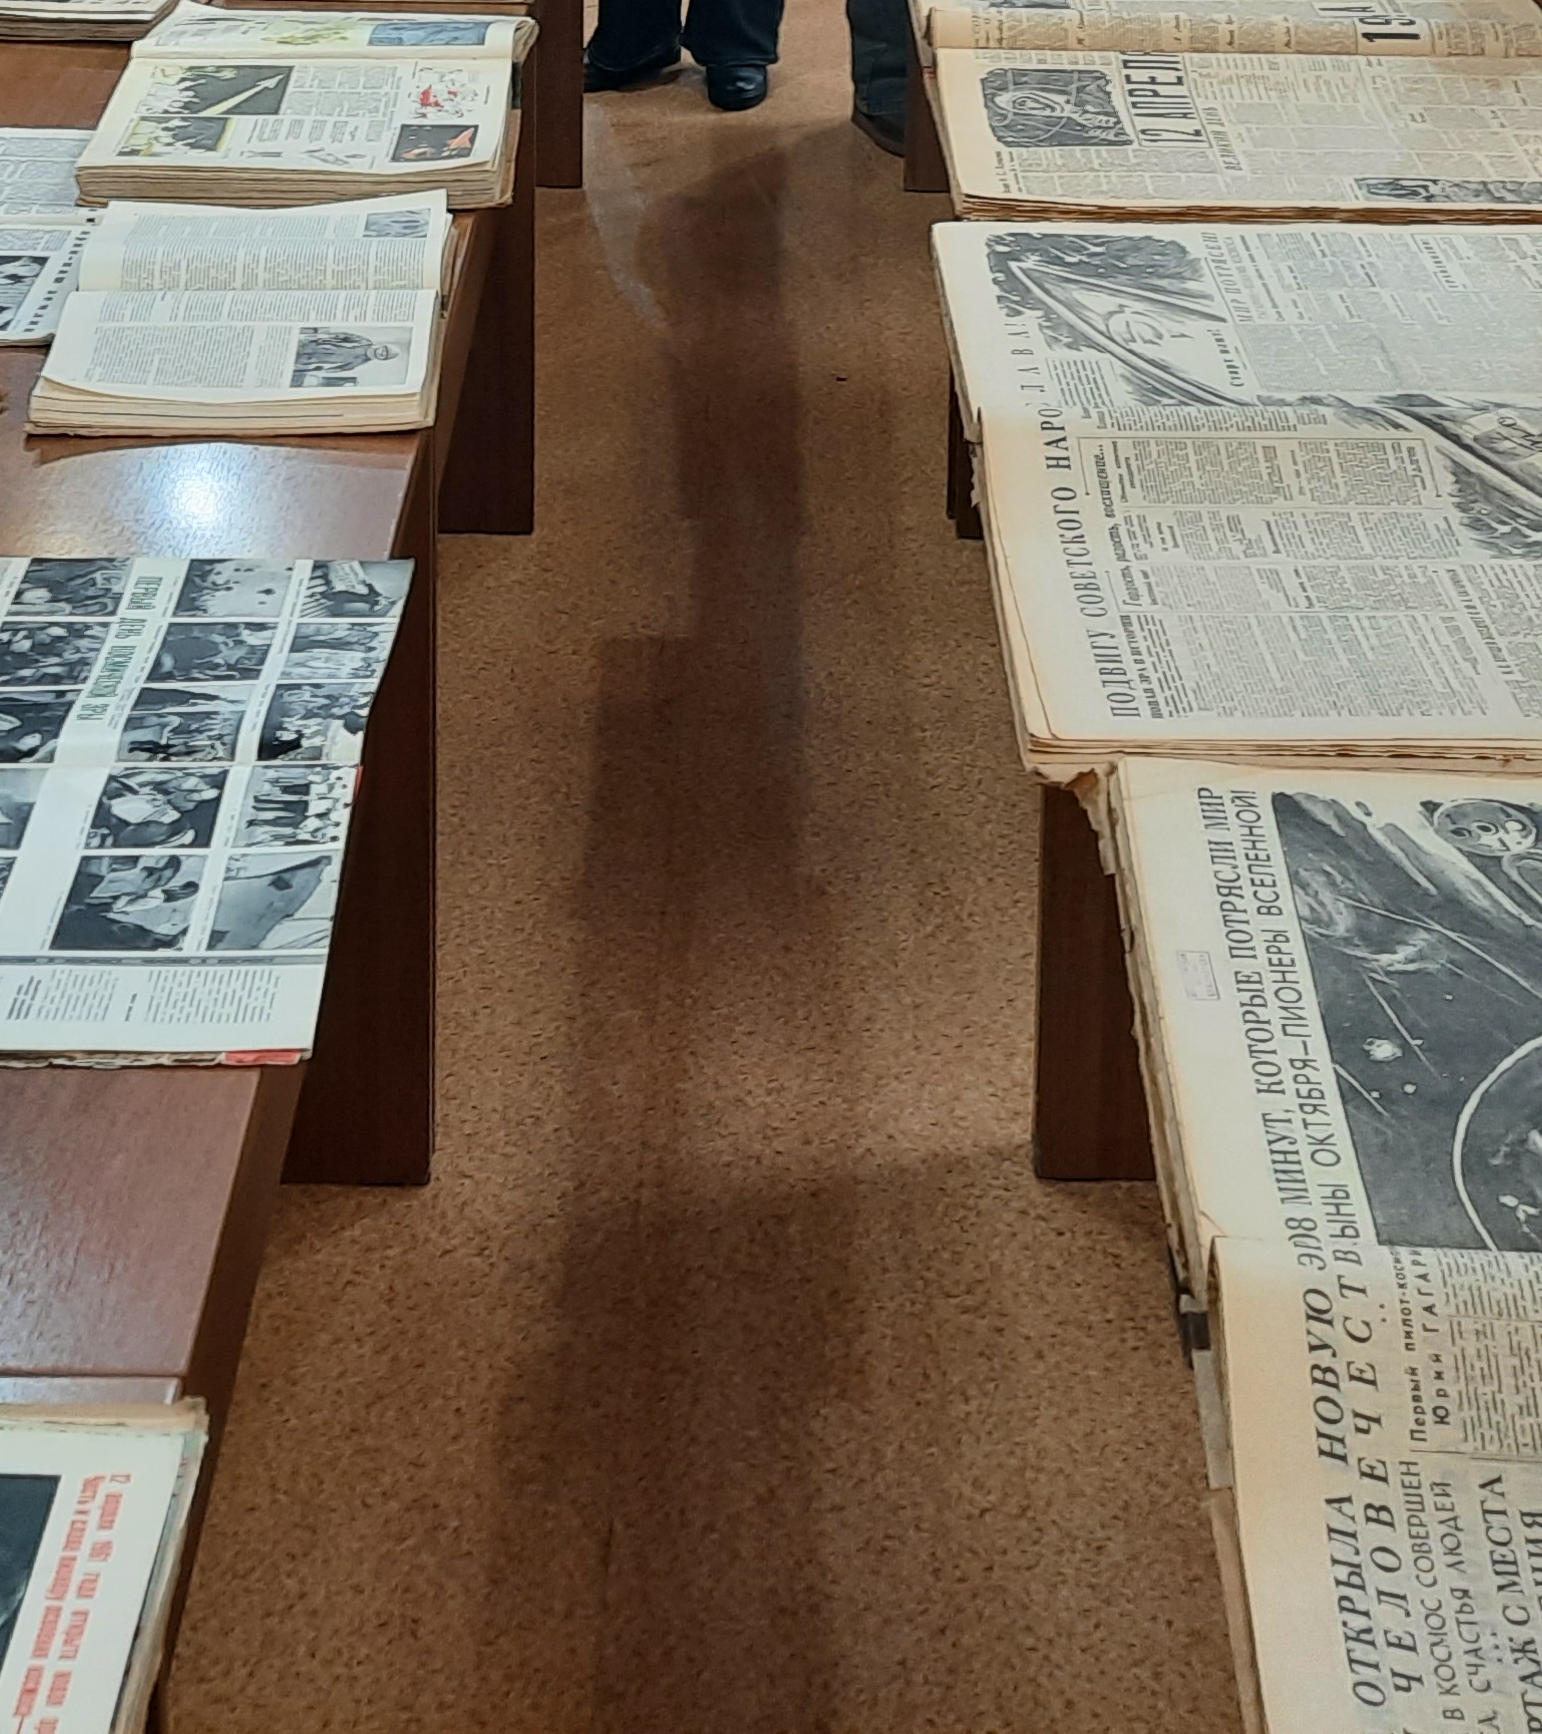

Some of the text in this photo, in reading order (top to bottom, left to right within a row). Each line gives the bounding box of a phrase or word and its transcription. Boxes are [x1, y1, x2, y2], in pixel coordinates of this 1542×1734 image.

[1140, 128, 1205, 143] 12
[1230, 298, 1254, 323] МИР
[1038, 408, 1141, 718] ПОДВИГУ СОВЕТСКОГО НАРО
[1197, 787, 1230, 831] МИР
[1230, 790, 1283, 916] ВСЕЛЕННОЙ!
[1208, 839, 1258, 960] ПОТРЯСЛИ
[1234, 970, 1286, 1095] КОТОРЫЕ
[1262, 1109, 1312, 1206] МИНУТ,
[1317, 1184, 1360, 1241] ЫНЫ
[1303, 1288, 1349, 1466] НОВУЮ
[1390, 1247, 1428, 1443] Первый пилот-косм
[1410, 1250, 1451, 1426] Юрий ГАГАРИ
[1332, 1249, 1424, 1694] ЧЕЛОВЕЧЕСТВ
[1429, 1480, 1467, 1574] ЛЮДЕЙ
[1399, 1461, 1466, 1721] В КОСМОС СОВЕРШЕН
[1478, 1474, 1525, 1596] МЕСТА
[1325, 1494, 1387, 1707] ОТКРЫЛА
[1450, 1587, 1492, 1693] СЧАСТЬЯ
[1502, 1604, 1532, 1628] С
